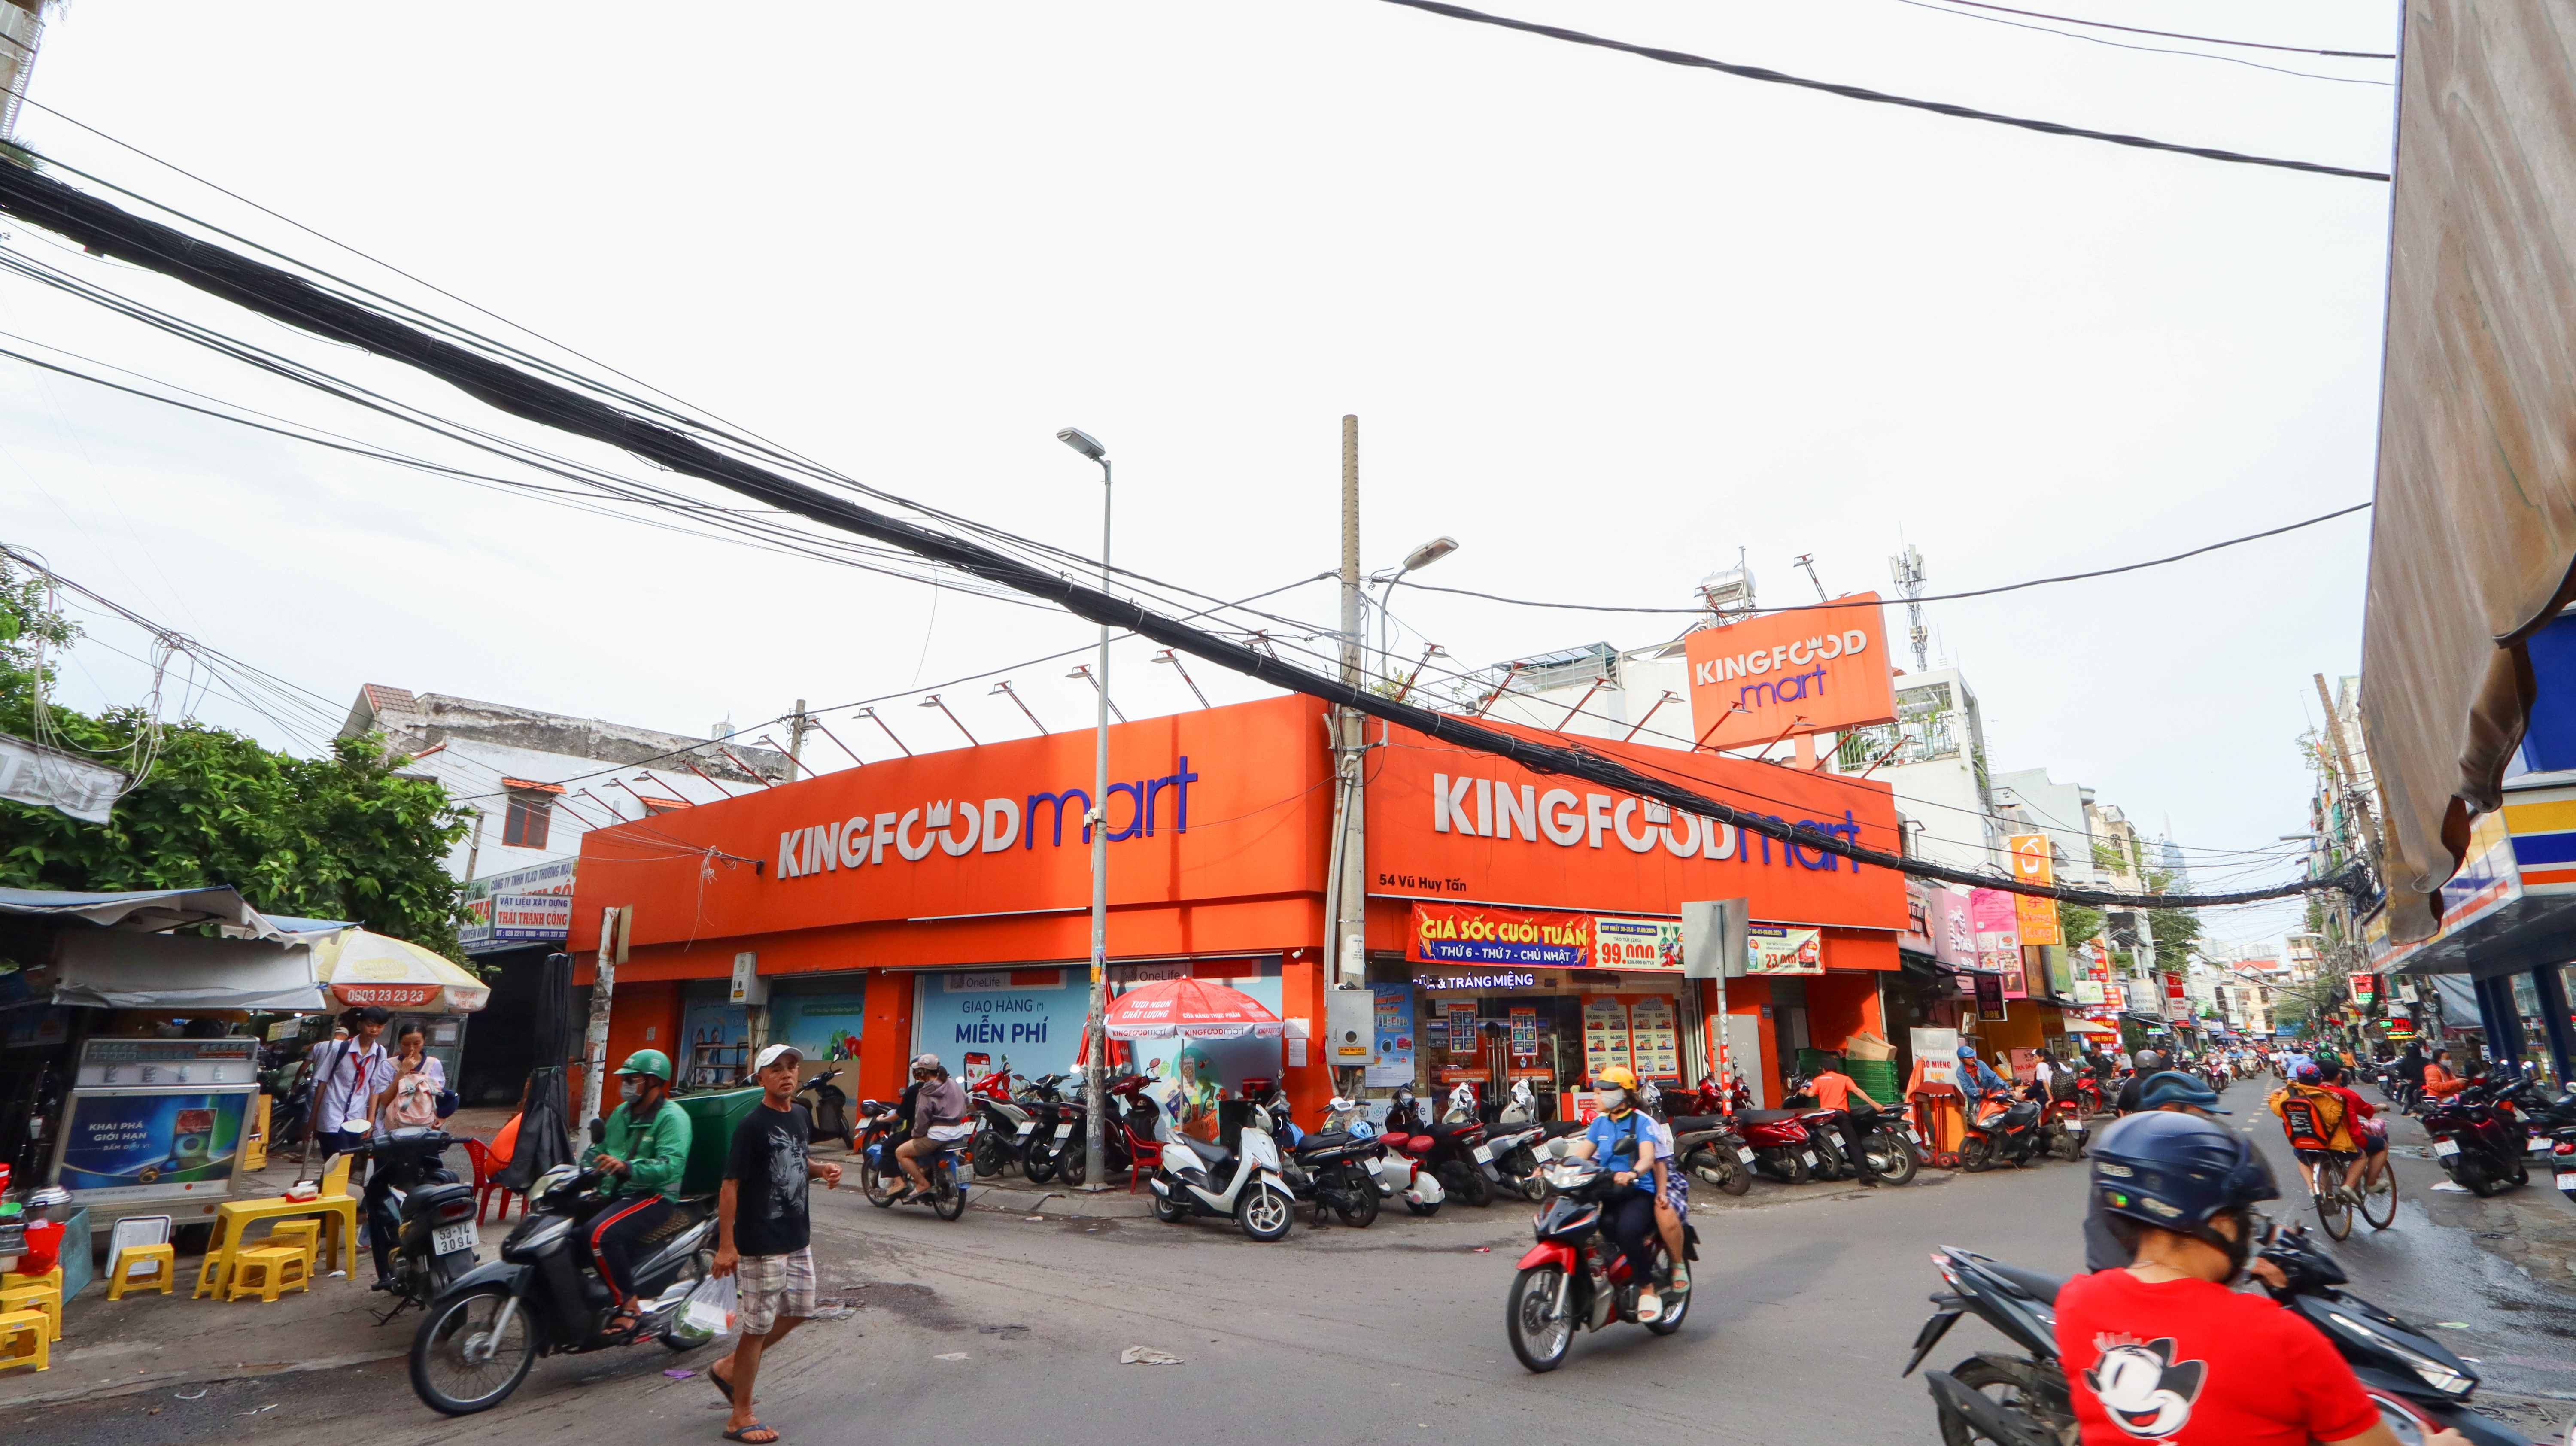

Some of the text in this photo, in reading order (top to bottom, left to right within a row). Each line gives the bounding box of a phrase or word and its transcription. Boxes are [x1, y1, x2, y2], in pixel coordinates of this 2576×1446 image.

[1696, 629, 1867, 686] KINGFOOD
[1741, 664, 1826, 709] mart
[1379, 874, 1395, 886] 54
[1419, 877, 1442, 892] Huy
[2022, 911, 2051, 925] Hong
[1421, 914, 1588, 946] GIÁ SỐC CUỐI TUẦN
[2025, 926, 2051, 940] Kong
[1440, 945, 1464, 957] THỨ
[1465, 948, 1472, 957] 6
[1482, 946, 1503, 958] THỨ
[1505, 949, 1510, 959] 7
[1521, 948, 1541, 960] CHỦ
[1543, 950, 1571, 964] NHẬT
[967, 977, 1000, 987] OneLife
[1140, 970, 1180, 981] OneLife
[1448, 972, 1491, 989] TRÁNG
[1493, 971, 1534, 989] MIỆNG
[348, 990, 423, 1002] 0903 23 23 23
[963, 1000, 992, 1013] GIAO
[996, 996, 1033, 1012] HÀNG
[1150, 1000, 1172, 1008] NGON
[956, 1015, 1048, 1044] MIỄN PHÍ
[120, 1121, 143, 1130] PHÁ
[122, 1132, 148, 1141] HẠN
